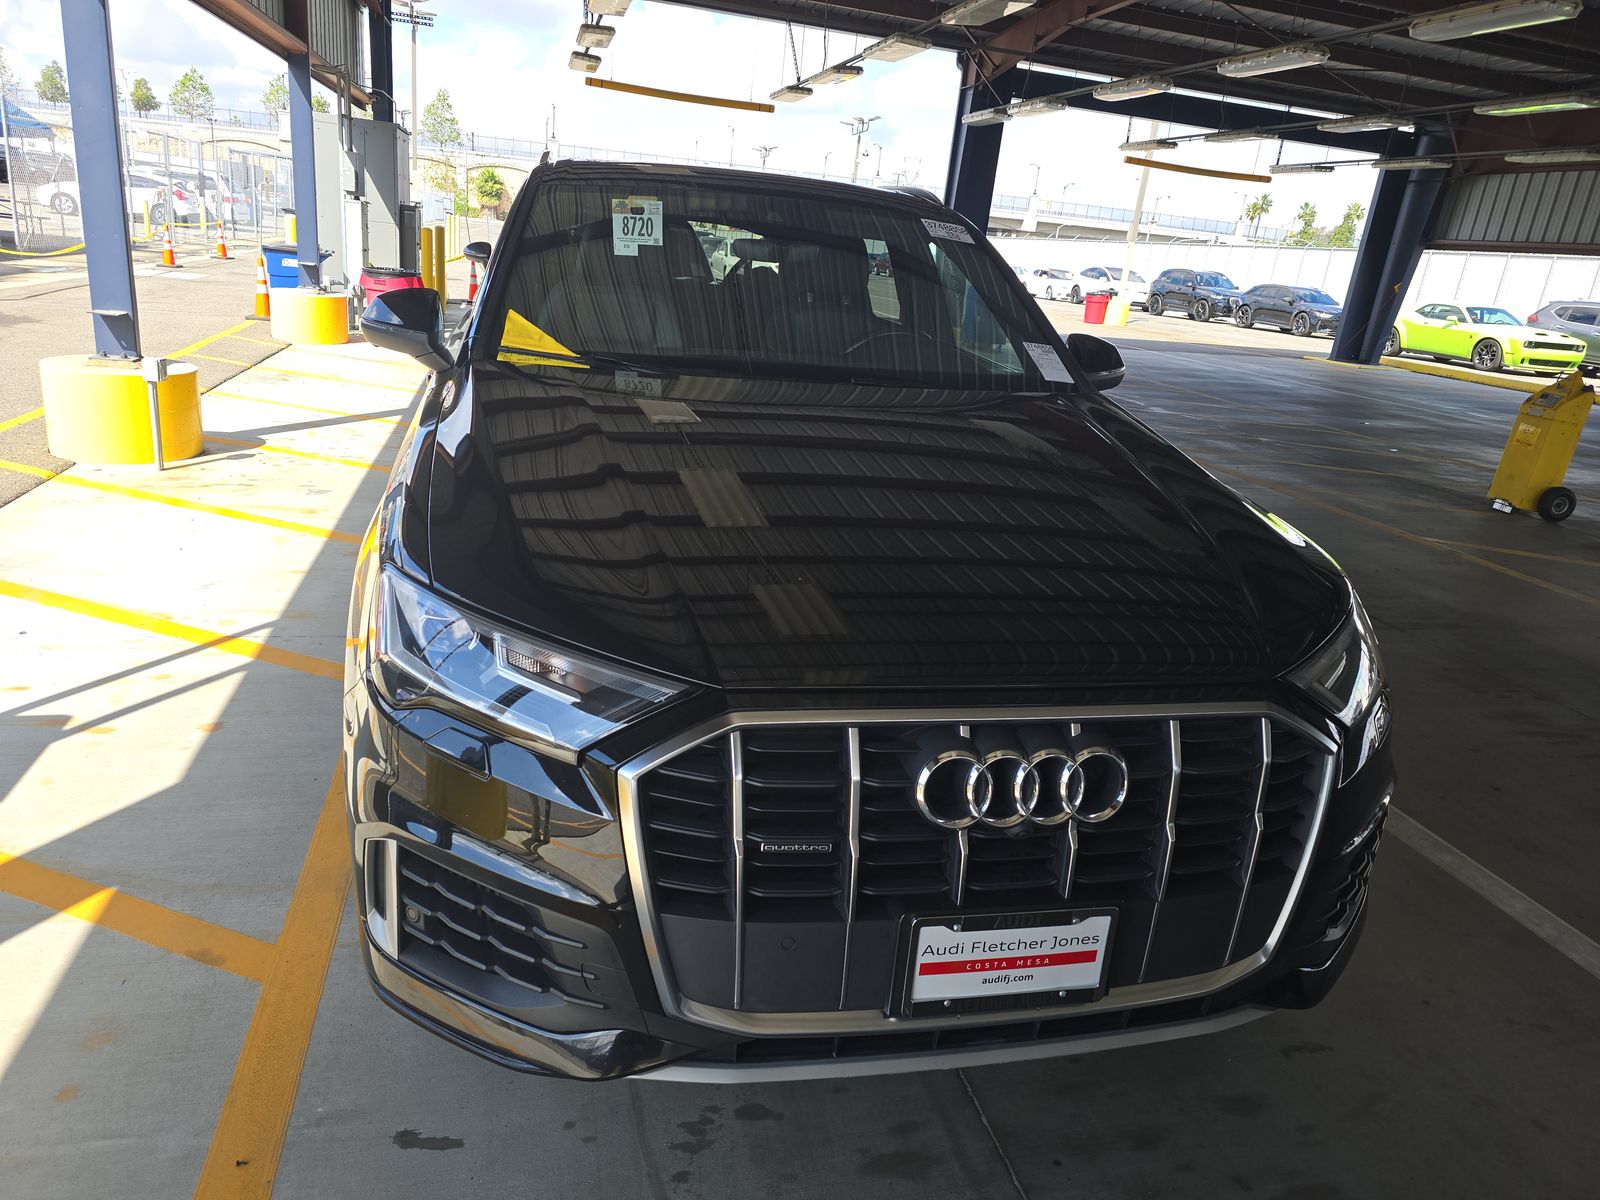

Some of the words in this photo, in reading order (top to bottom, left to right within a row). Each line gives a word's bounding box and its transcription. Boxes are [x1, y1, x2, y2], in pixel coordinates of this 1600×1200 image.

[622, 216, 654, 238] 8720
[764, 844, 828, 852] quattro
[921, 942, 964, 957] Audi
[971, 938, 1047, 954] Fletcher
[1051, 934, 1100, 950] Jones
[966, 960, 1008, 970] COSTA
[1016, 958, 1050, 966] MESA
[981, 973, 1034, 985] audifj.com
